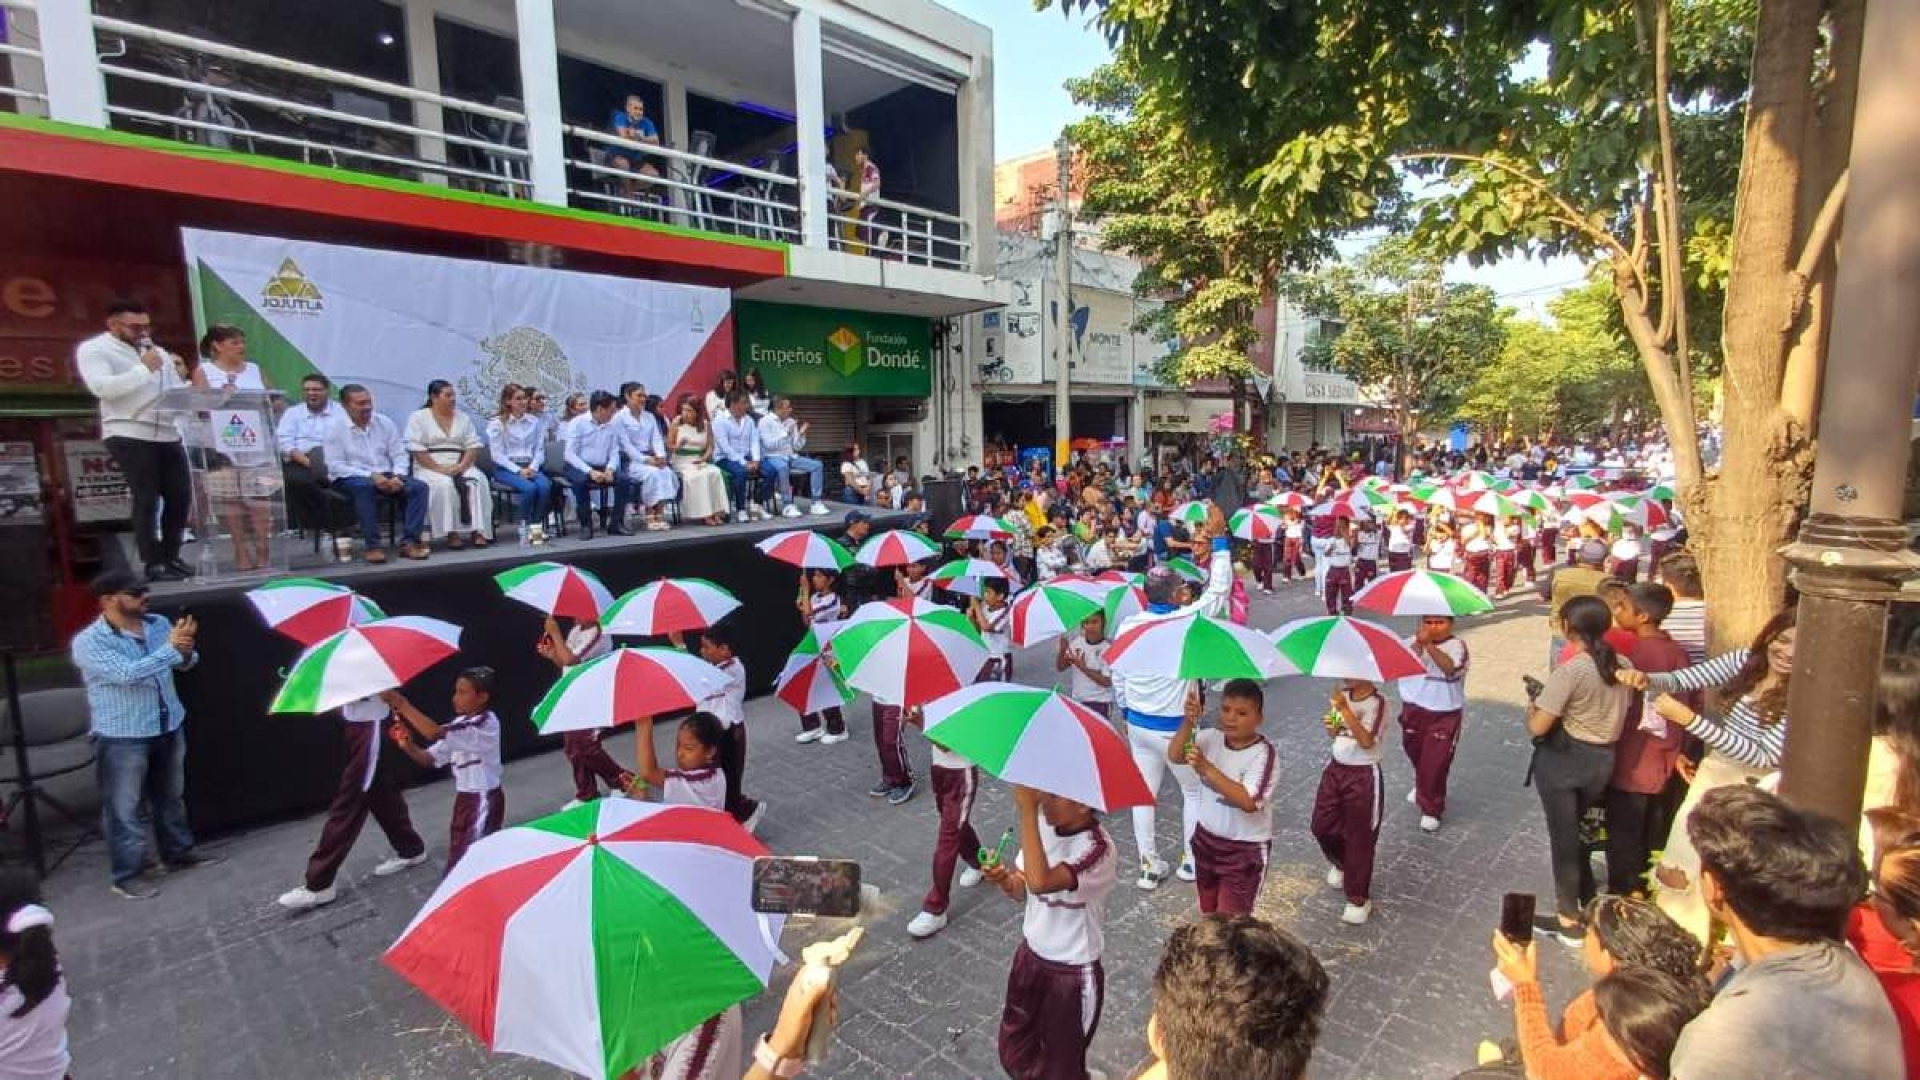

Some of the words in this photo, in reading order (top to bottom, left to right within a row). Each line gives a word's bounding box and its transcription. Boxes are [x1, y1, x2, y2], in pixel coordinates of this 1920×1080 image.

[261, 297, 323, 310] JOJUTLA
[1089, 332, 1122, 346] MONTE
[751, 343, 823, 368] Empeños
